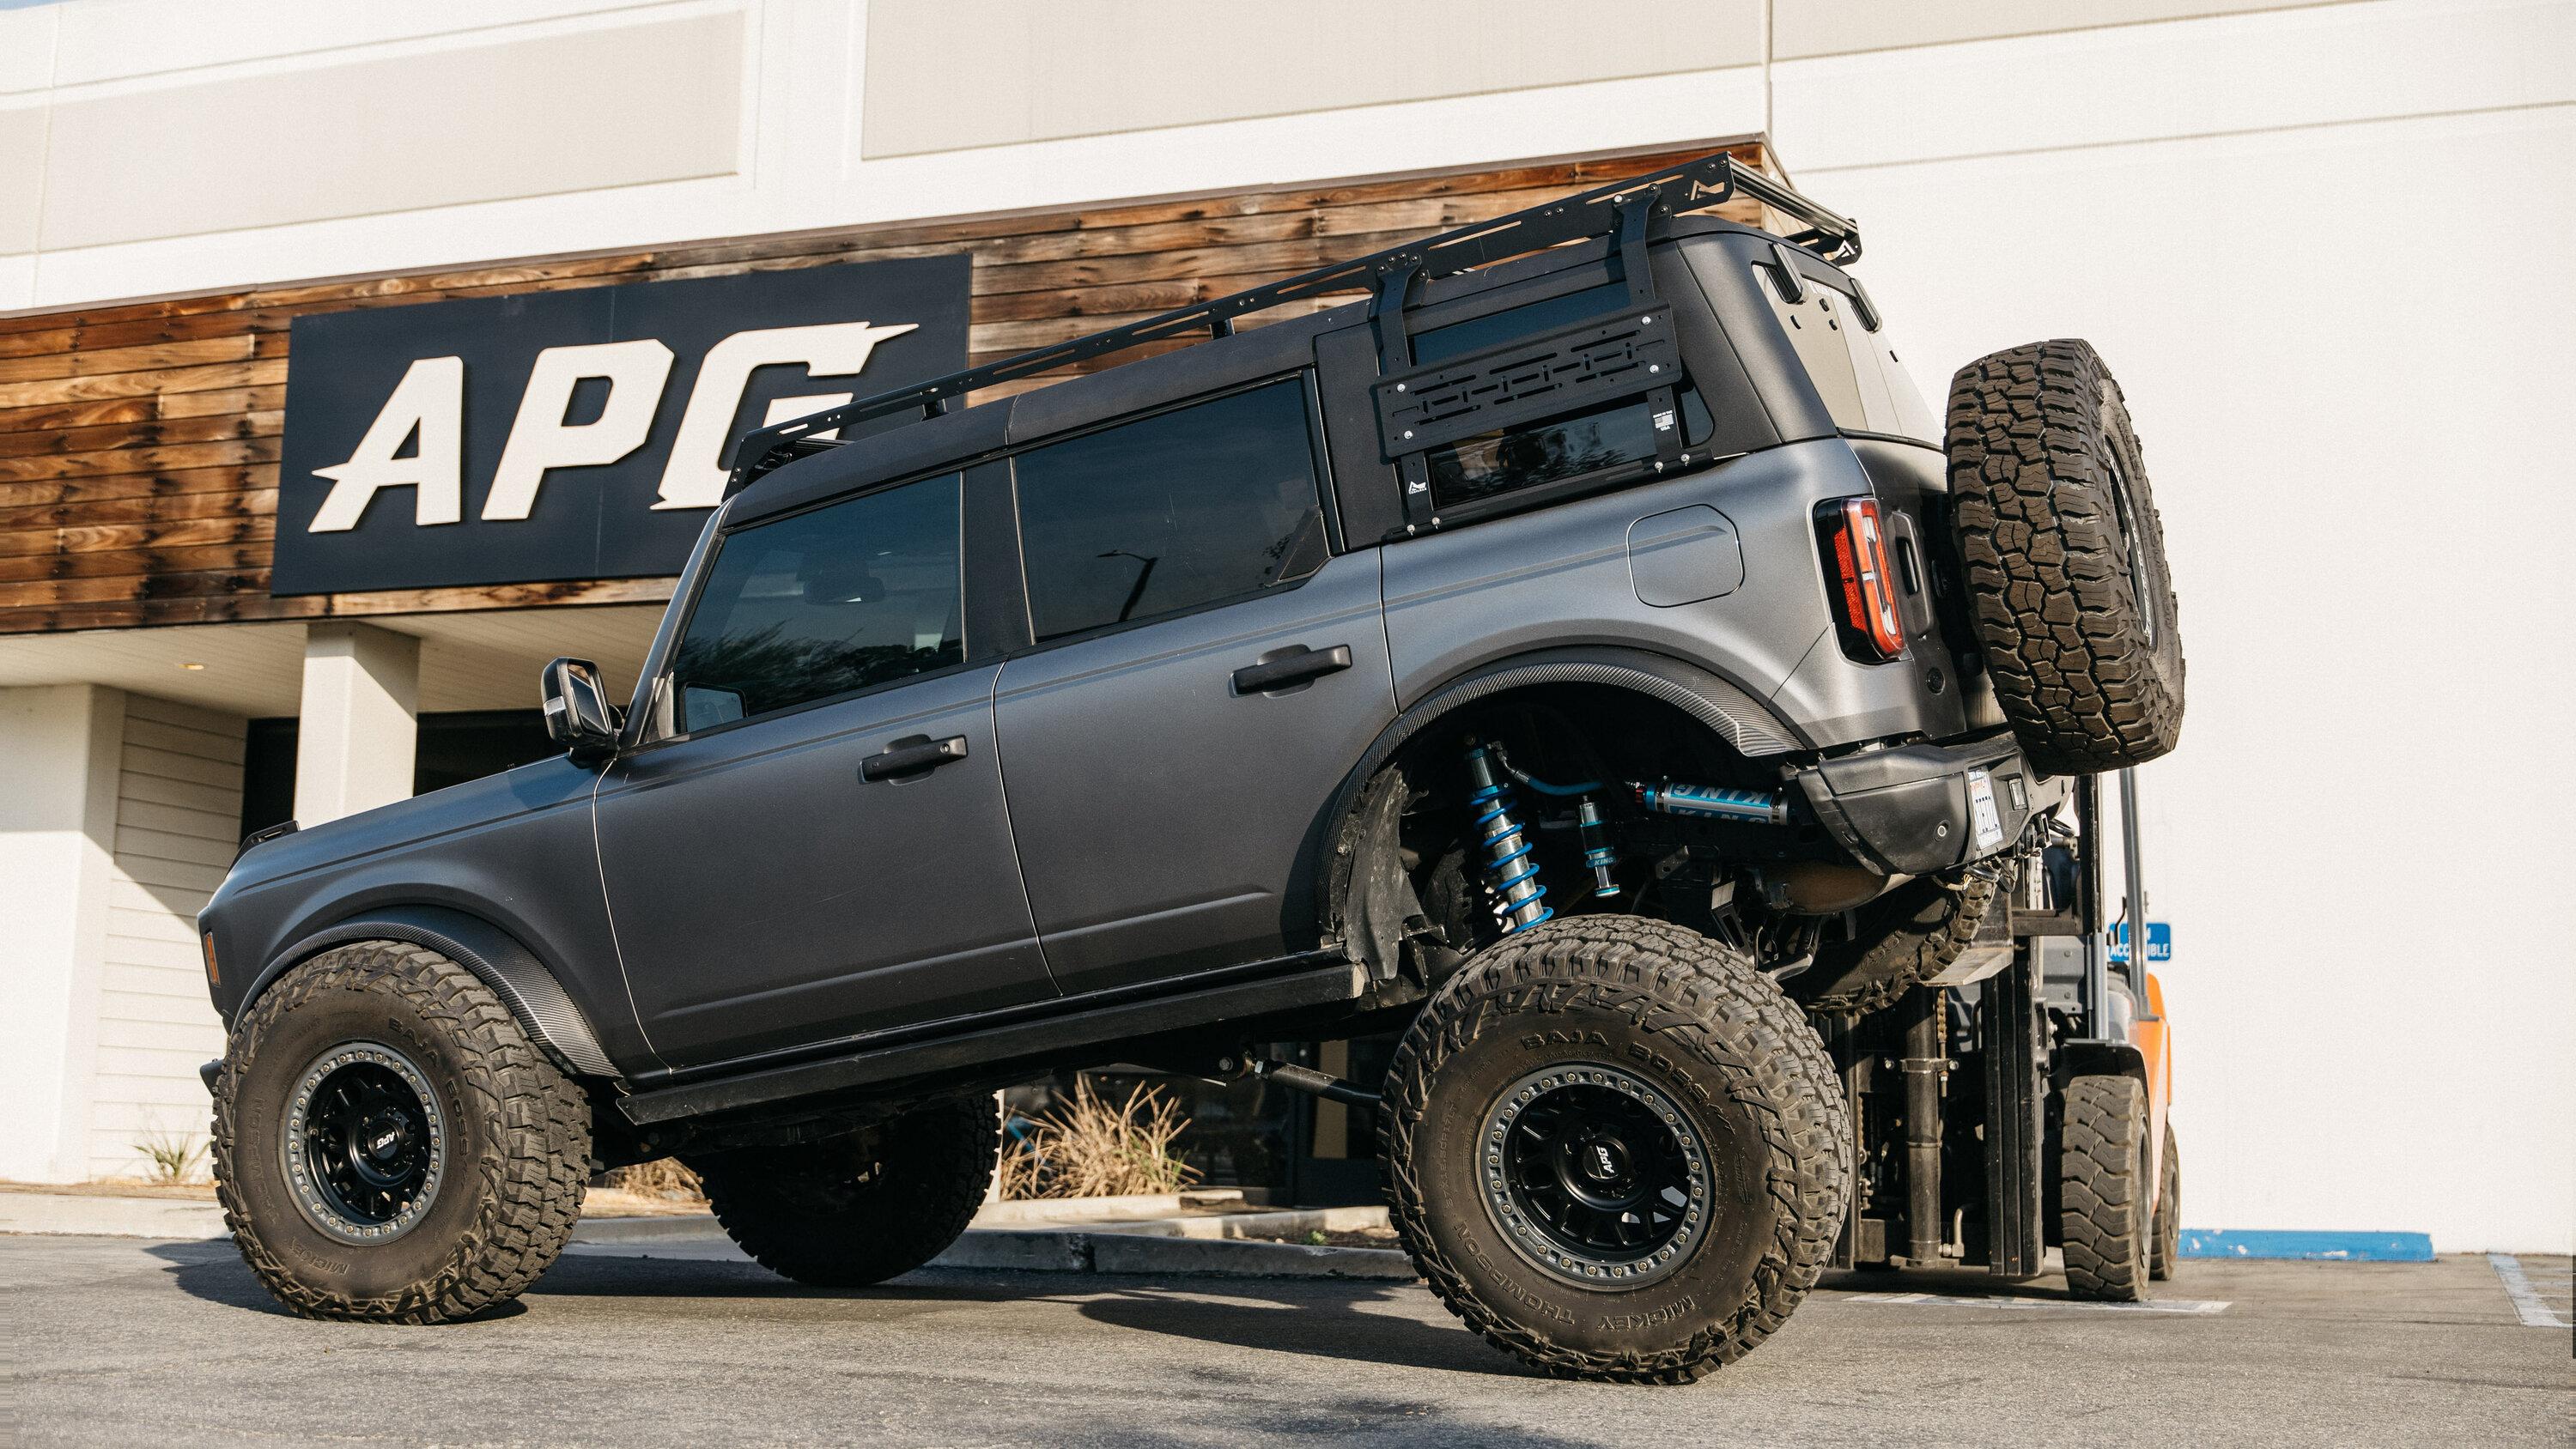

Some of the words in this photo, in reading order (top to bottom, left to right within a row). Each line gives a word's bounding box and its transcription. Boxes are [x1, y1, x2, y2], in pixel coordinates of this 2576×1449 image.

[307, 320, 920, 533] APG
[1674, 783, 1766, 804] KING
[2110, 943, 2170, 957] ACCIBLE
[1521, 1028, 1609, 1051] BAJA
[1630, 1040, 1710, 1105] BOSS
[446, 1079, 469, 1156] BOSS
[376, 1131, 395, 1149] APG
[1596, 1145, 1615, 1173] APG
[1456, 1222, 1577, 1325] THOMPSON
[1597, 1295, 1697, 1331] MICKEY
